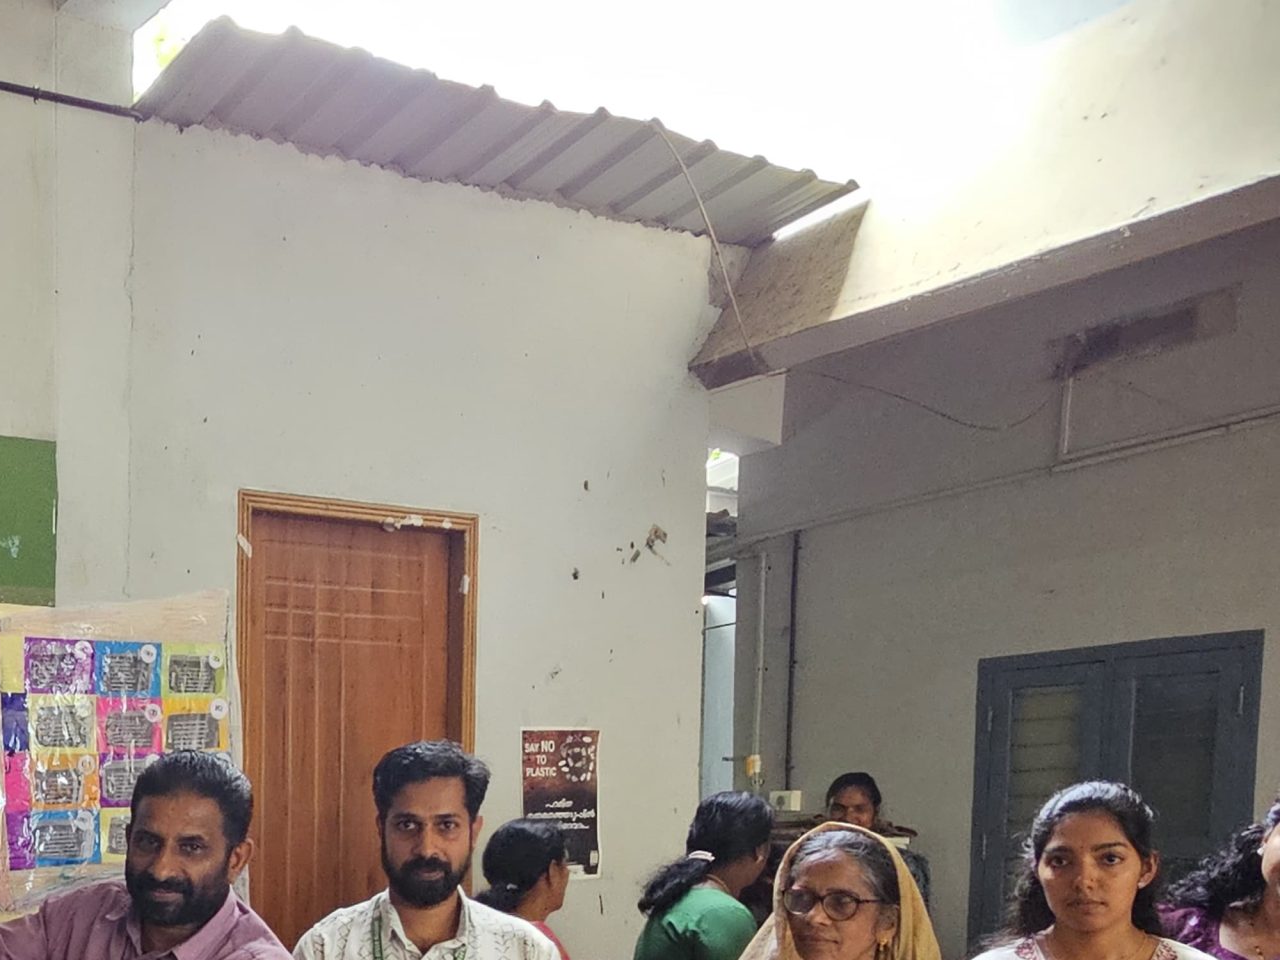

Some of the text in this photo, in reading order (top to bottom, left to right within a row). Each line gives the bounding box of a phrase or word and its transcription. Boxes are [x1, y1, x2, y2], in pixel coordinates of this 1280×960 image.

[524, 740, 555, 753] SAY NO
[536, 754, 547, 765] TO
[526, 767, 557, 777] PLASTIC
